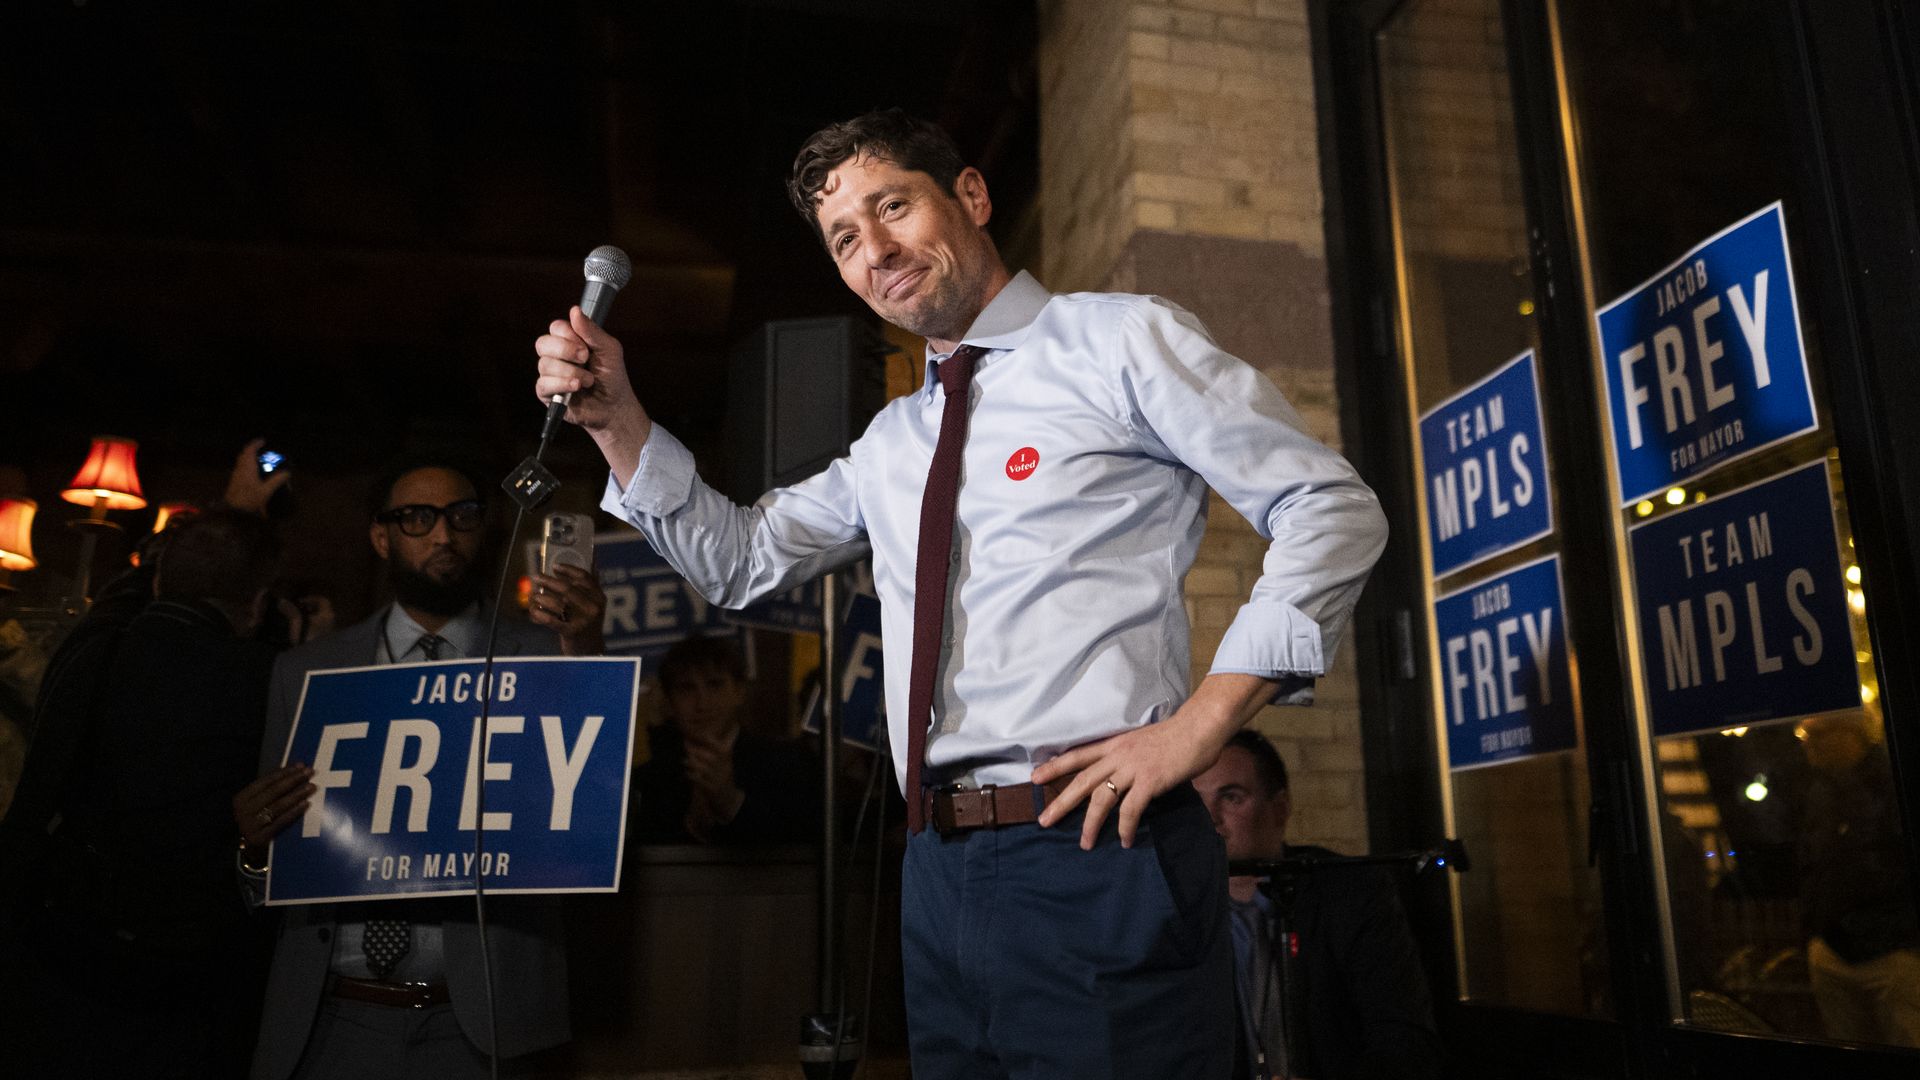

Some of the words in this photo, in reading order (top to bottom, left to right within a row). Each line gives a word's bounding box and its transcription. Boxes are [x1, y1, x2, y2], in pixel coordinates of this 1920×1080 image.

[1656, 259, 1709, 316] JACOB
[1619, 268, 1771, 450] FREY
[1446, 395, 1505, 453] TEAM
[1671, 443, 1697, 472] FOR
[1699, 419, 1744, 459] MAYOR
[1009, 460, 1036, 473] Voted
[1021, 453, 1025, 462] I
[1434, 432, 1534, 542] MPLS
[1678, 511, 1773, 579] TEAM
[602, 580, 709, 636] REY
[1472, 582, 1512, 620] JACOB
[1657, 567, 1823, 691] MPLS
[411, 671, 517, 705] JACOB
[1447, 607, 1552, 726] FREY
[302, 715, 605, 838] FREY
[366, 854, 411, 881] FOR
[423, 852, 510, 878] MAYOR
